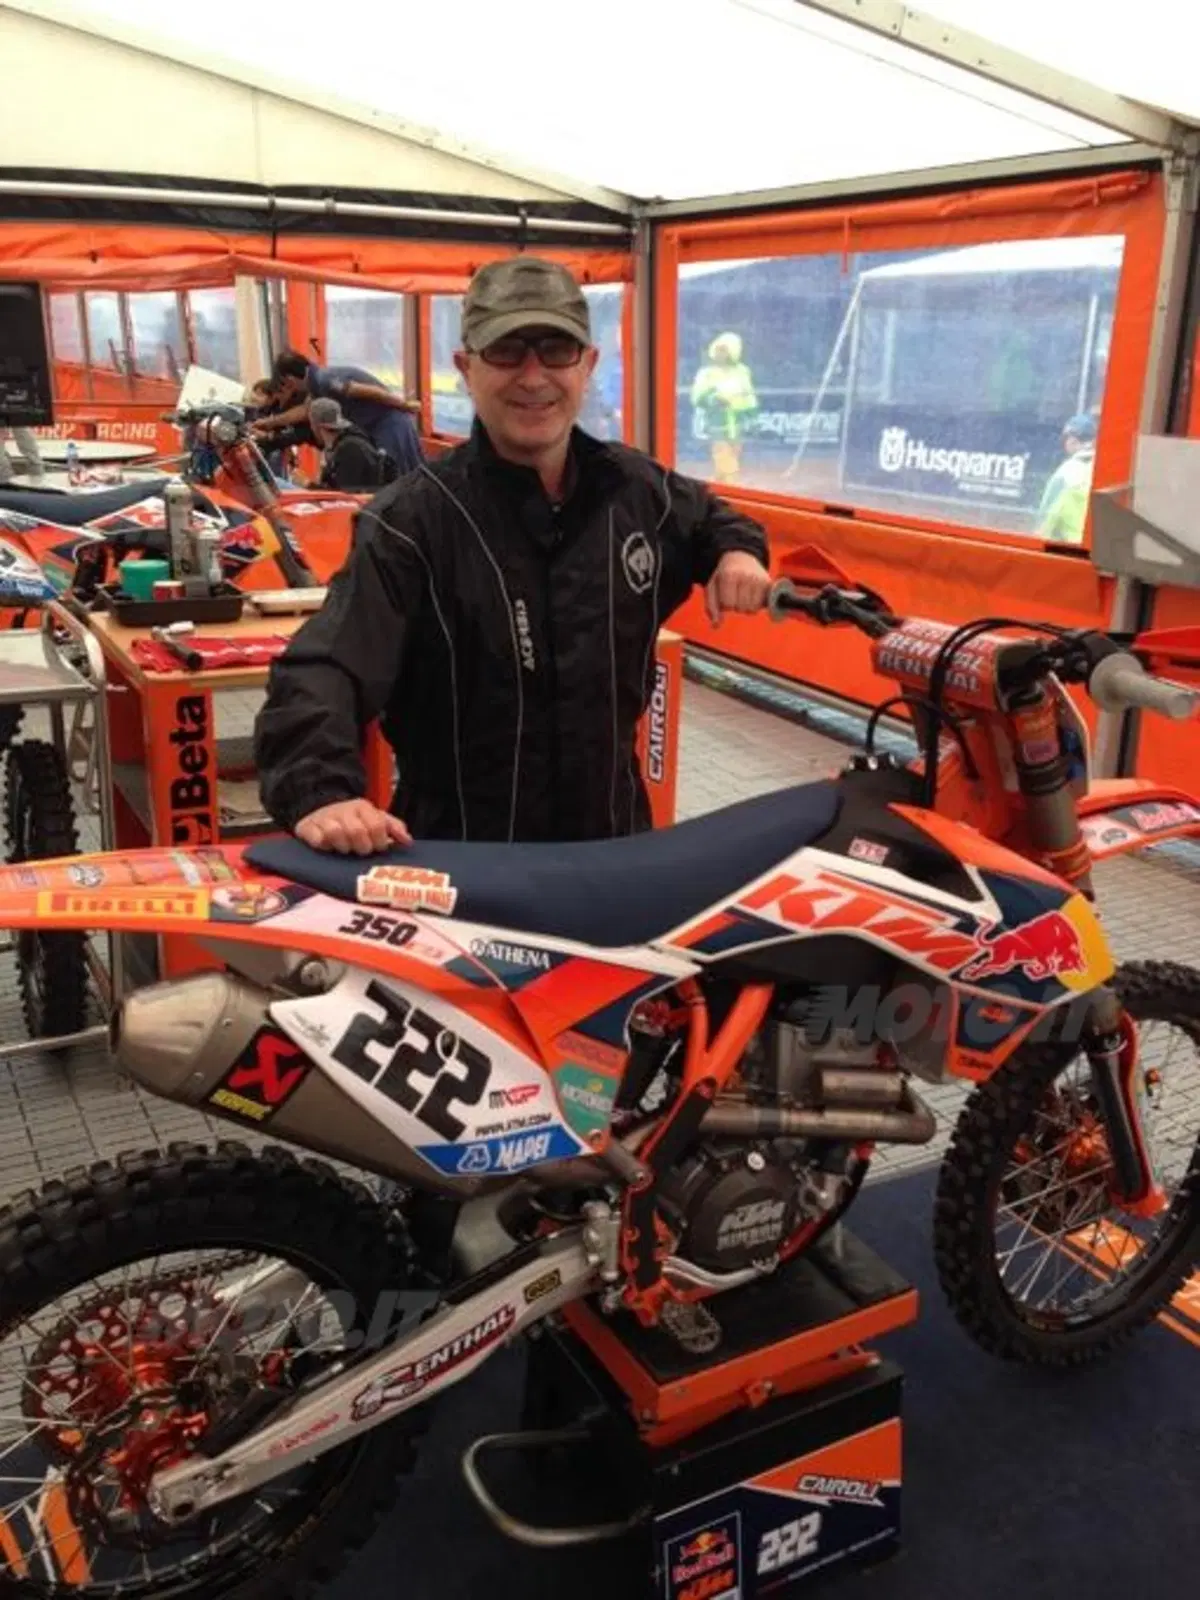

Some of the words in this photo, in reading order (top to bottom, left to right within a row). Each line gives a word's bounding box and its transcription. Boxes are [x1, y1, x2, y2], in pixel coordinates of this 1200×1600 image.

[905, 440, 1026, 480] Husqvarna
[169, 696, 209, 810] Beta
[51, 889, 197, 914] PIRELLI
[338, 910, 418, 946] 350
[738, 872, 981, 973] KTM
[485, 939, 550, 968] ATHENA
[330, 978, 492, 1142] 222
[495, 1132, 553, 1170] MAPEI
[351, 1303, 516, 1421] RENTHAL
[798, 1475, 879, 1498] CAIROLI
[757, 1512, 822, 1574] 222
